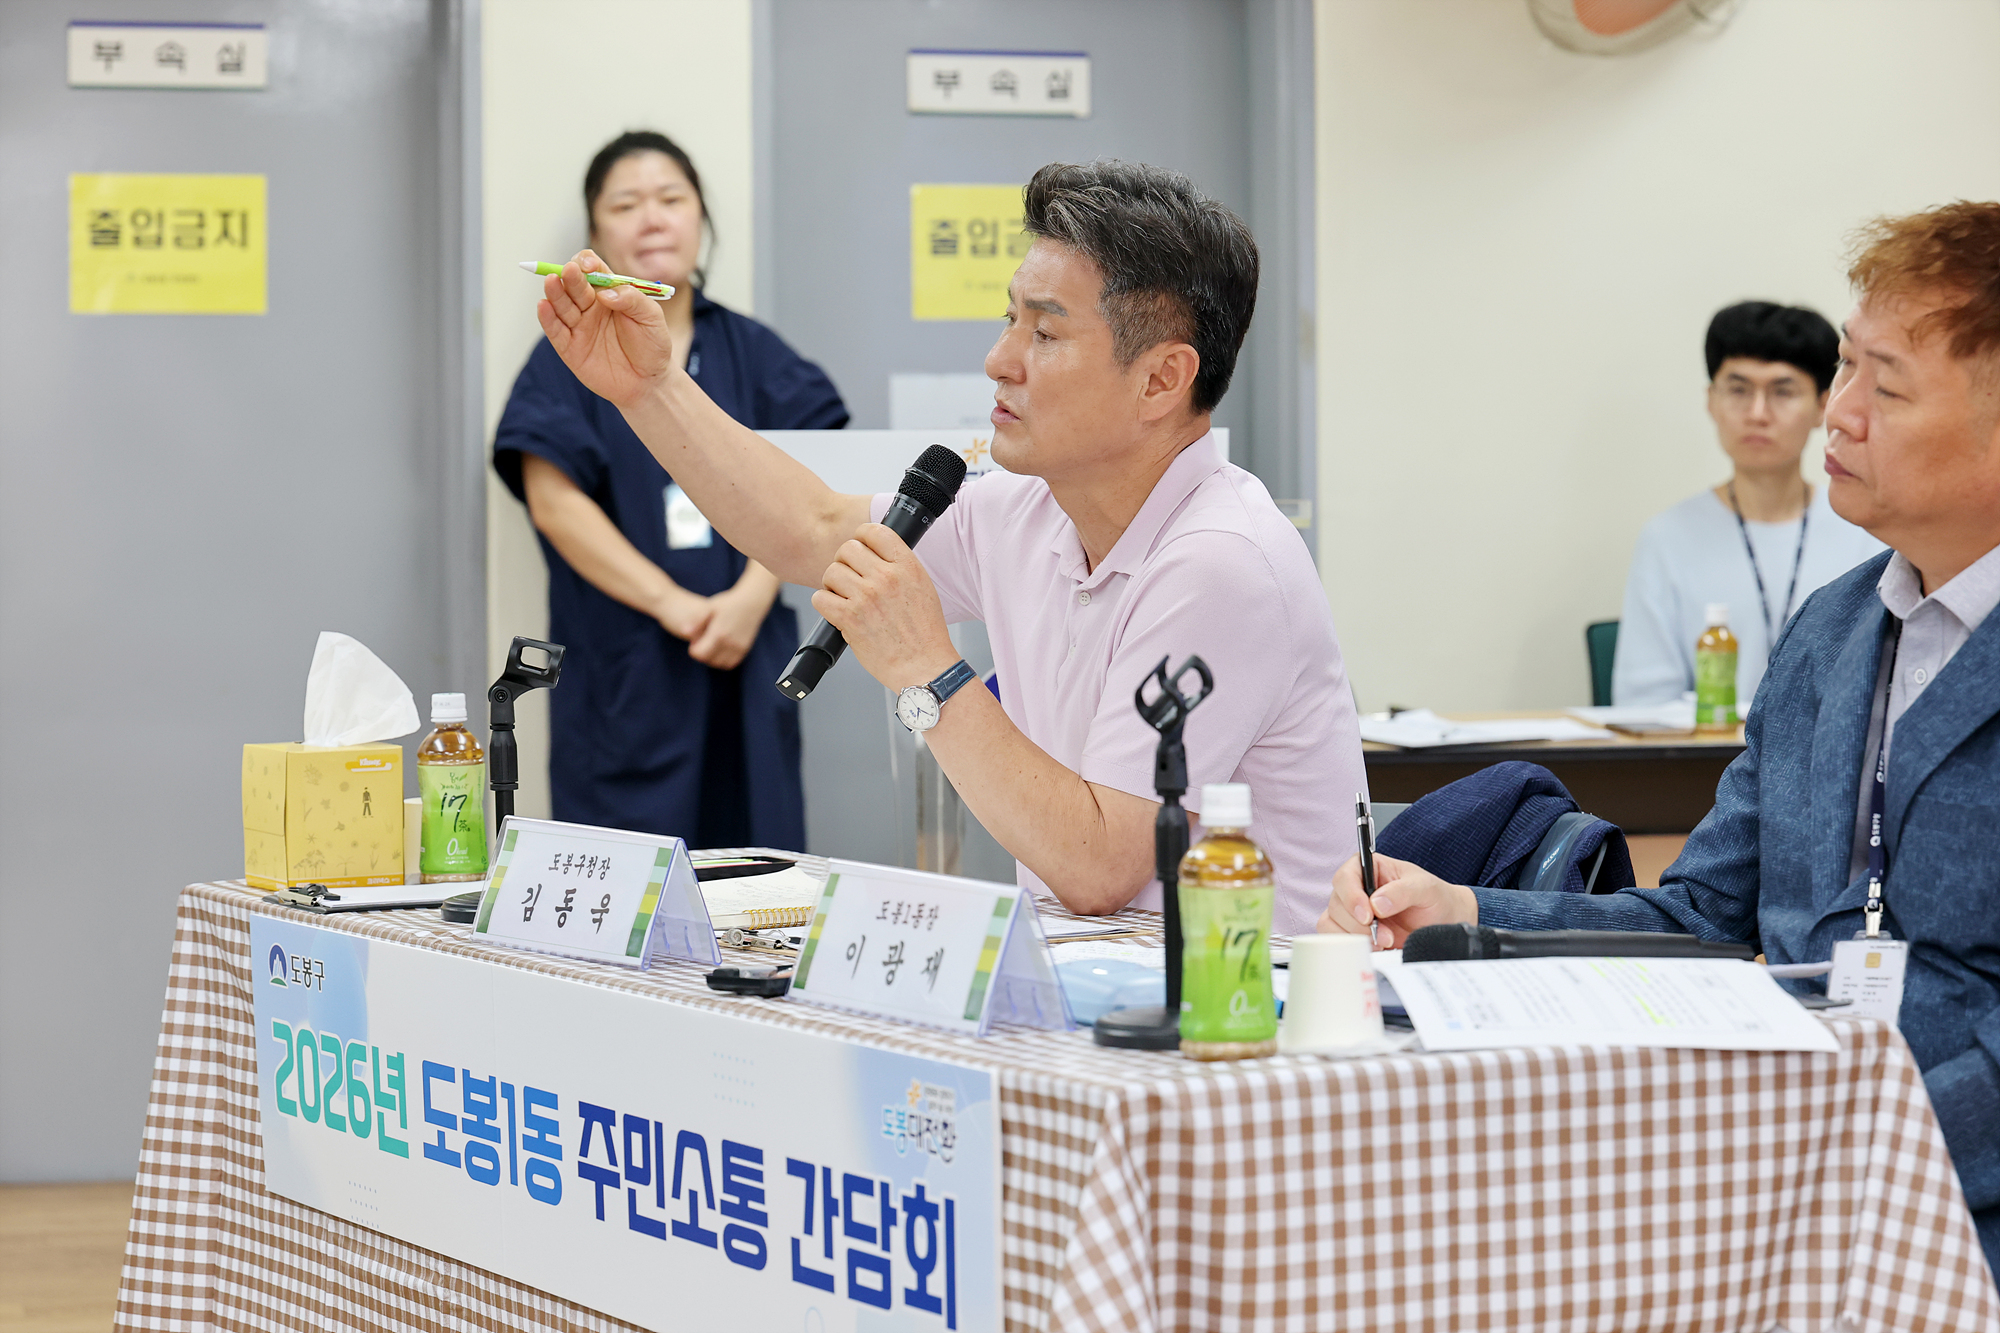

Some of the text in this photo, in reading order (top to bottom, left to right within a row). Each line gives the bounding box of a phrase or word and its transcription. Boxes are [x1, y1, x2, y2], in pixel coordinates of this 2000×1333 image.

[88, 207, 249, 250] 출입금지
[929, 217, 1036, 259] 출입금
[548, 852, 611, 880] 도봉구청장
[876, 901, 939, 931] 도봉1동장
[290, 955, 325, 991] 도봉구
[272, 1020, 957, 1331] 2026년 도봉1동 주민소통 간담회
